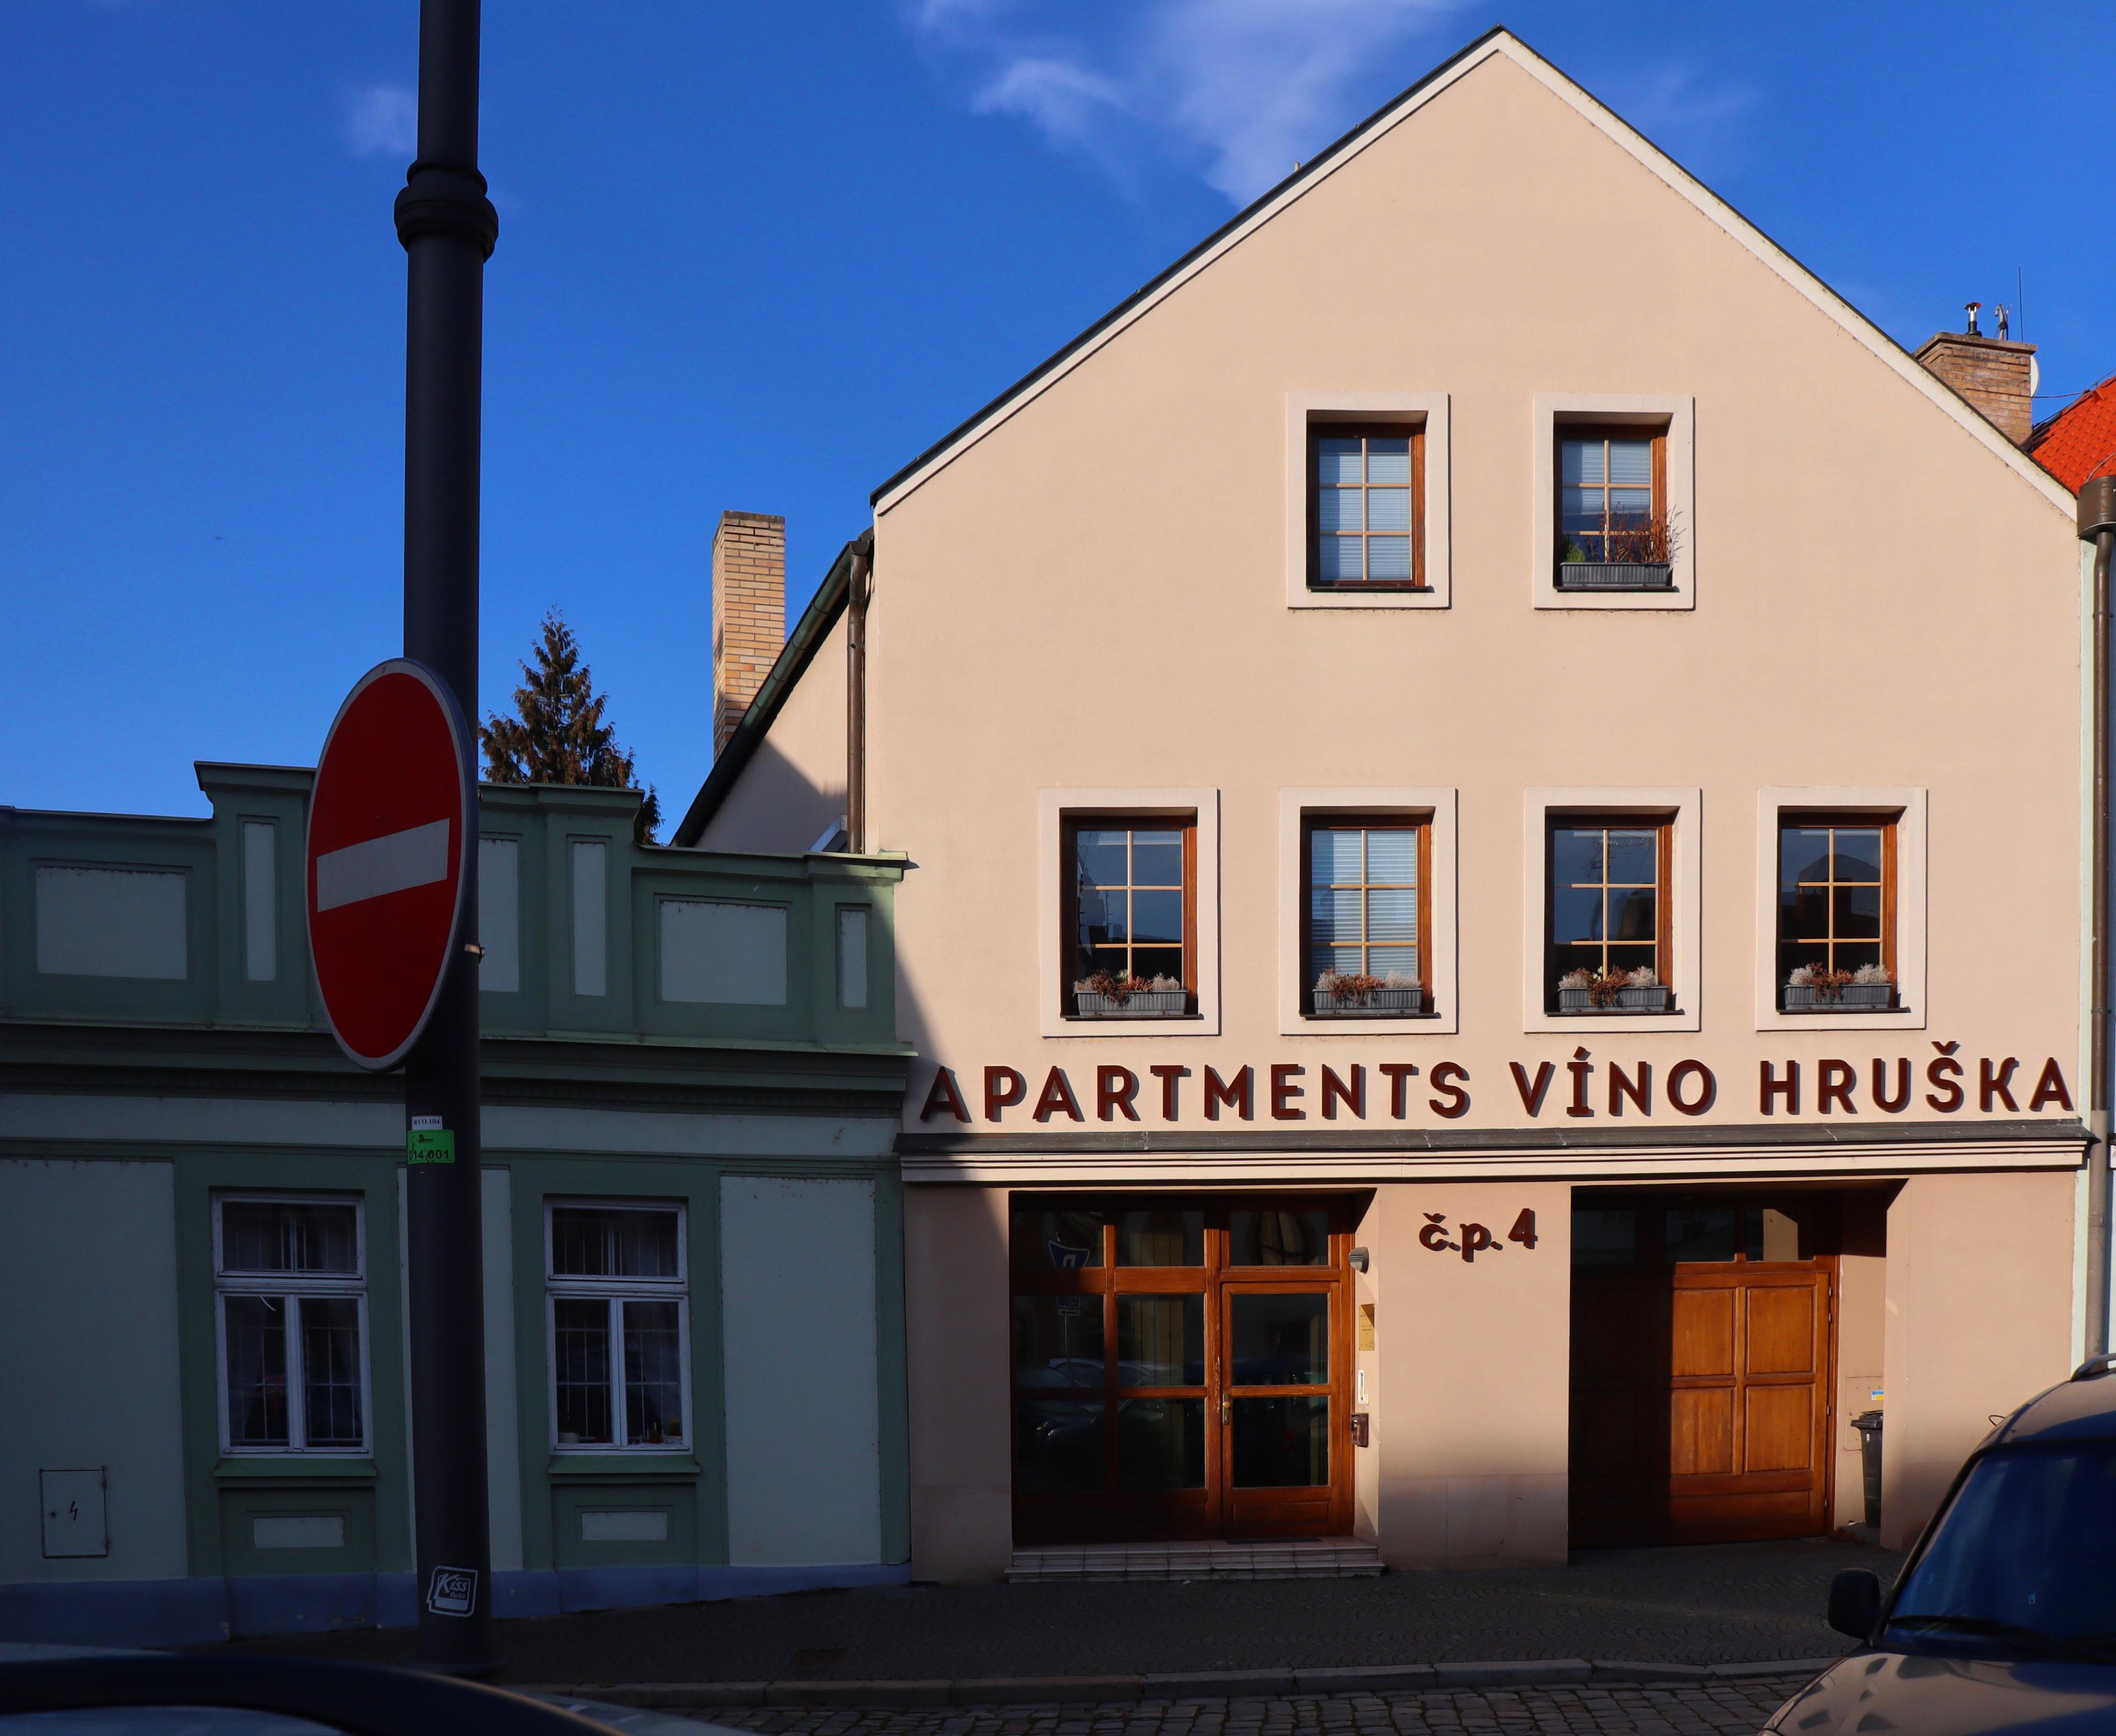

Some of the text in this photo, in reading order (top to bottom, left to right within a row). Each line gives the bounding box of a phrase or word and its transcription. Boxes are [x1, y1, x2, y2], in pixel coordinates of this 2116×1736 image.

[920, 1042, 2072, 1121] APARTMENTS VÍNO HRUŠKA
[434, 1573, 468, 1599] Kiss
